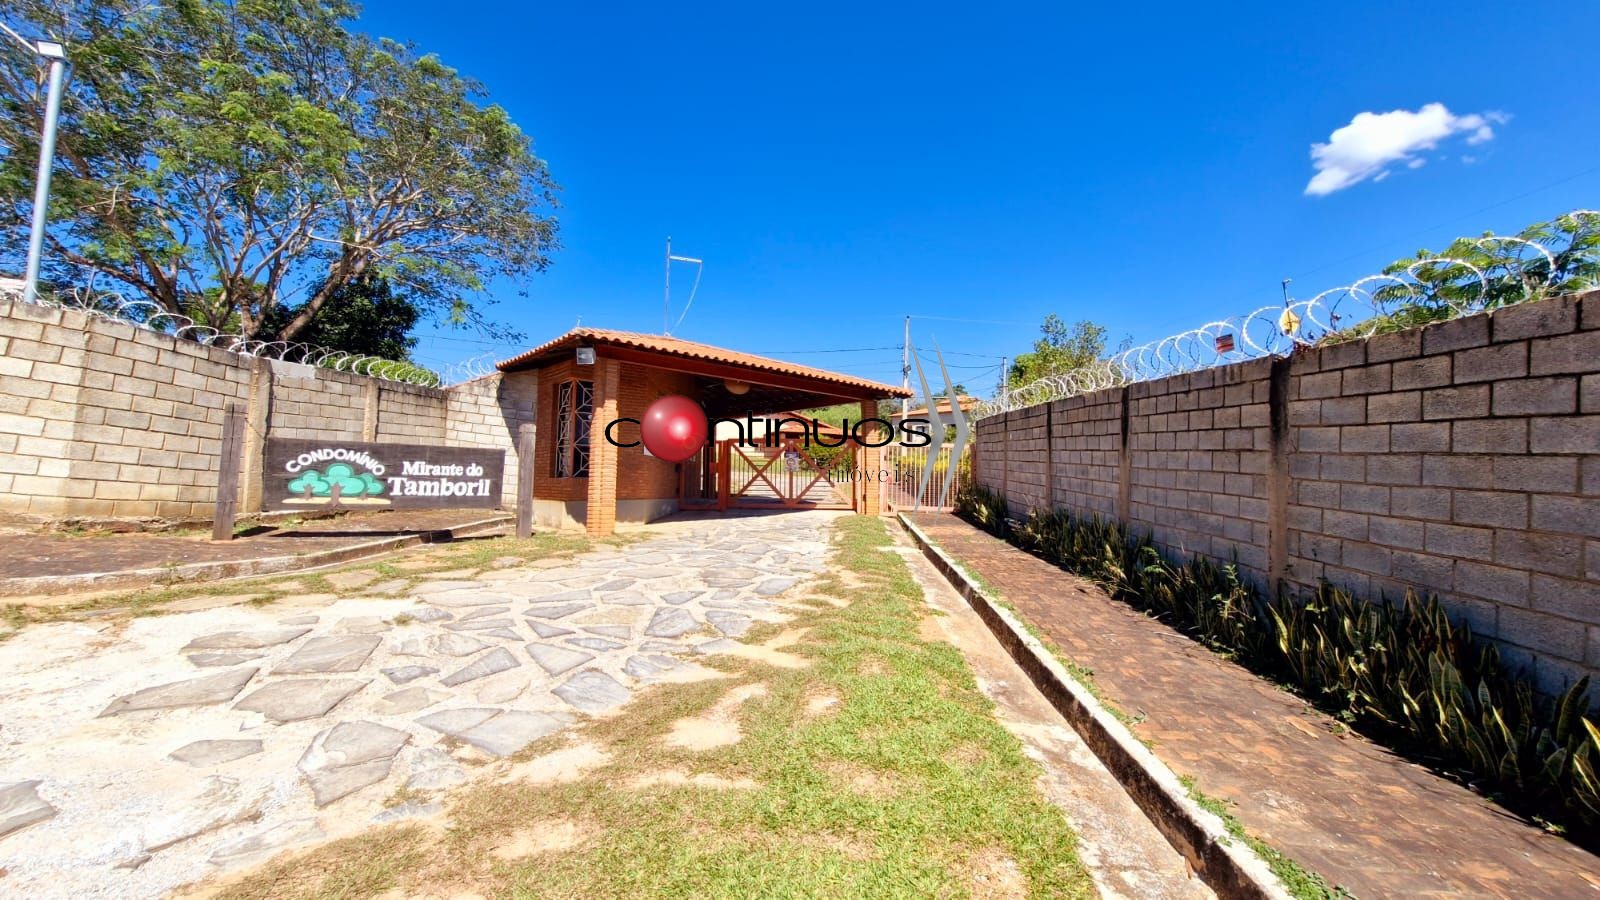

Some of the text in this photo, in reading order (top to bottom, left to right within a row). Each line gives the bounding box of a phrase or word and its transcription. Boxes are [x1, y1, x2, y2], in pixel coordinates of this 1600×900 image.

[285, 448, 385, 476] CONDOMÍNIO
[402, 461, 483, 477] Mirante do
[388, 478, 491, 497] Tamboril
